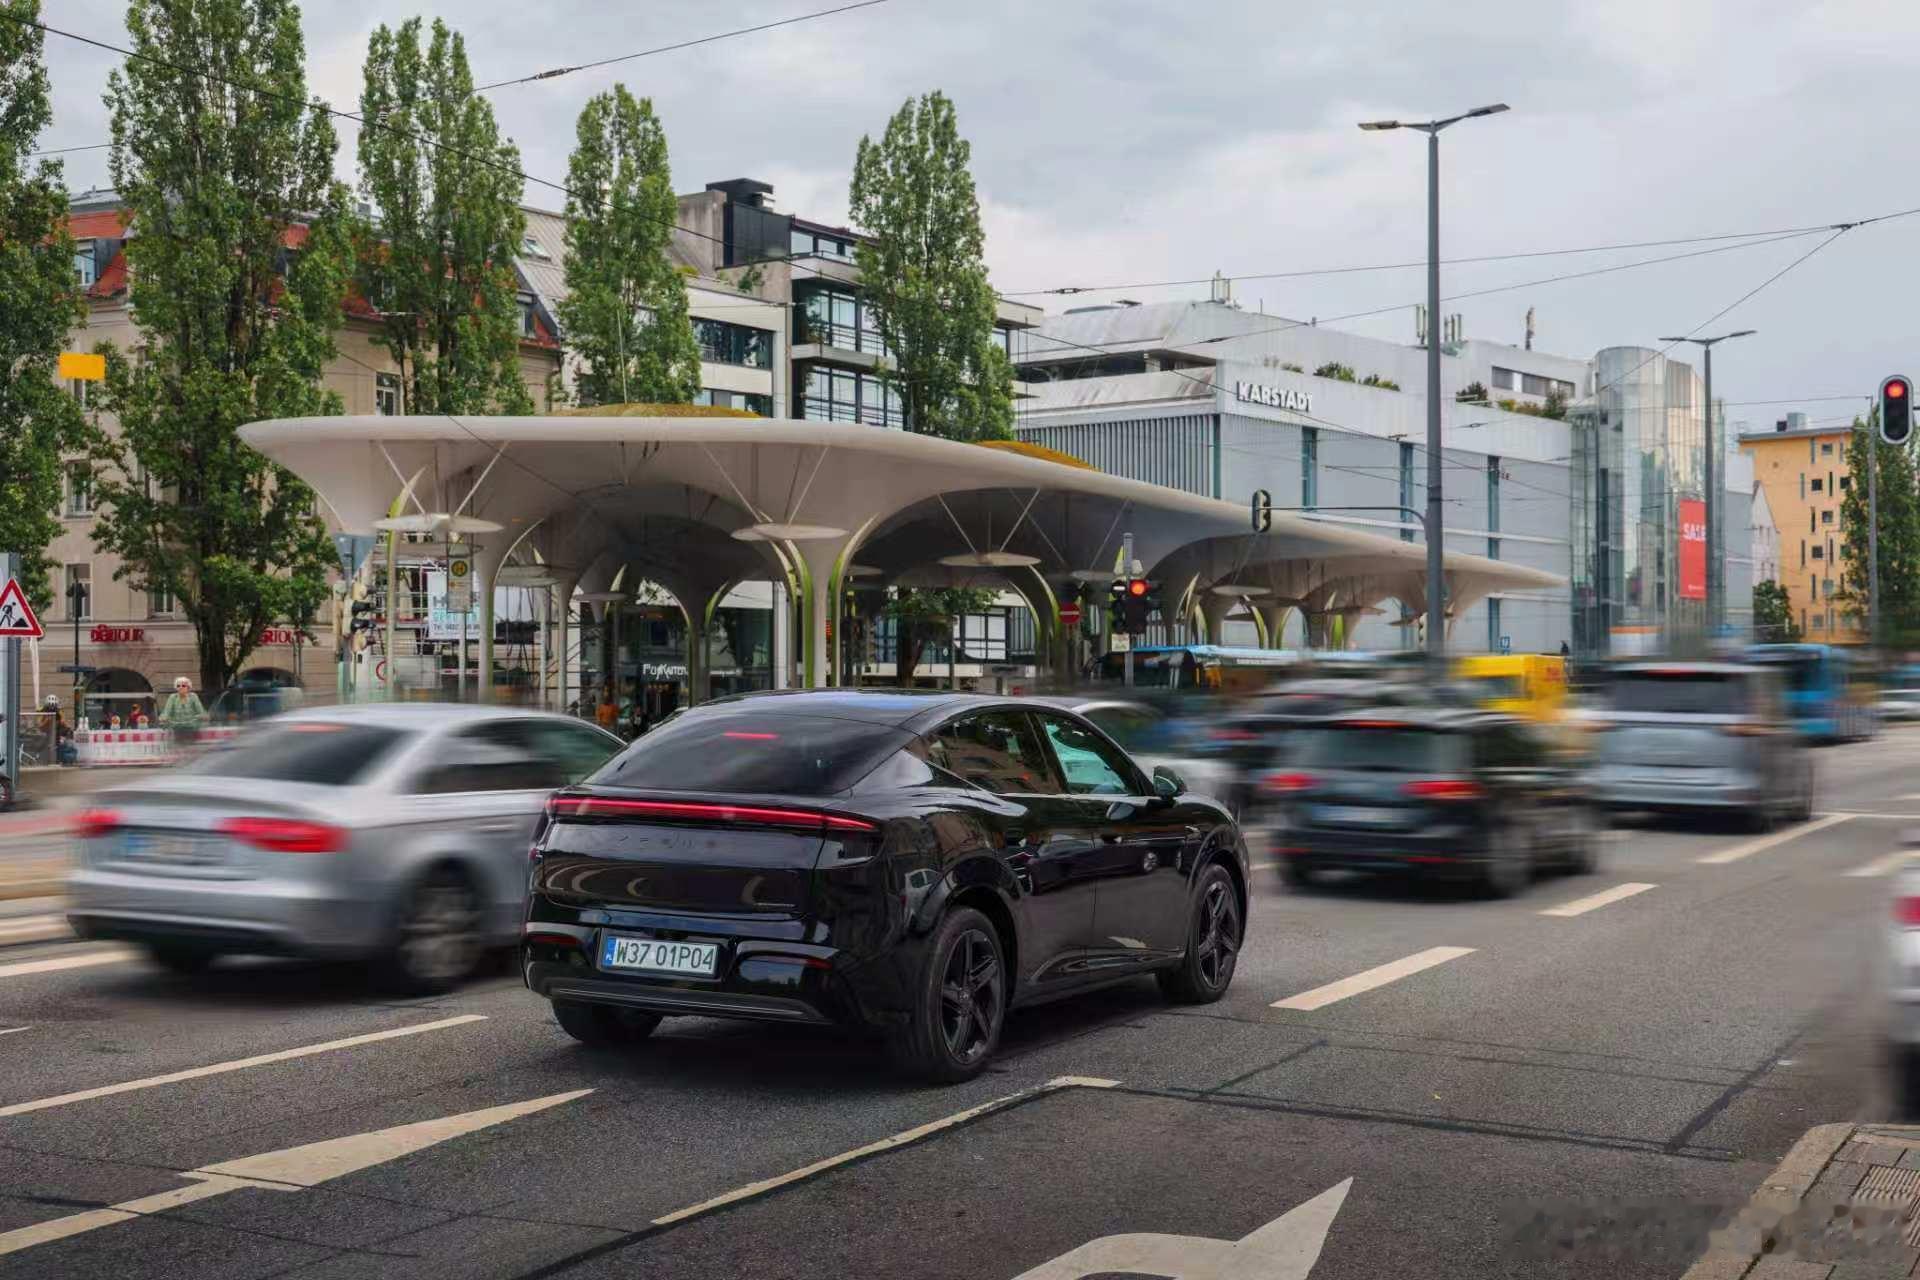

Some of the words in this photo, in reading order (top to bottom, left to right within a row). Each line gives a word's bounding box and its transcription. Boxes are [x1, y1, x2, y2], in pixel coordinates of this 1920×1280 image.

[1236, 381, 1313, 412] KARSTADT
[616, 941, 651, 965] W37
[655, 944, 715, 970] 01P04
